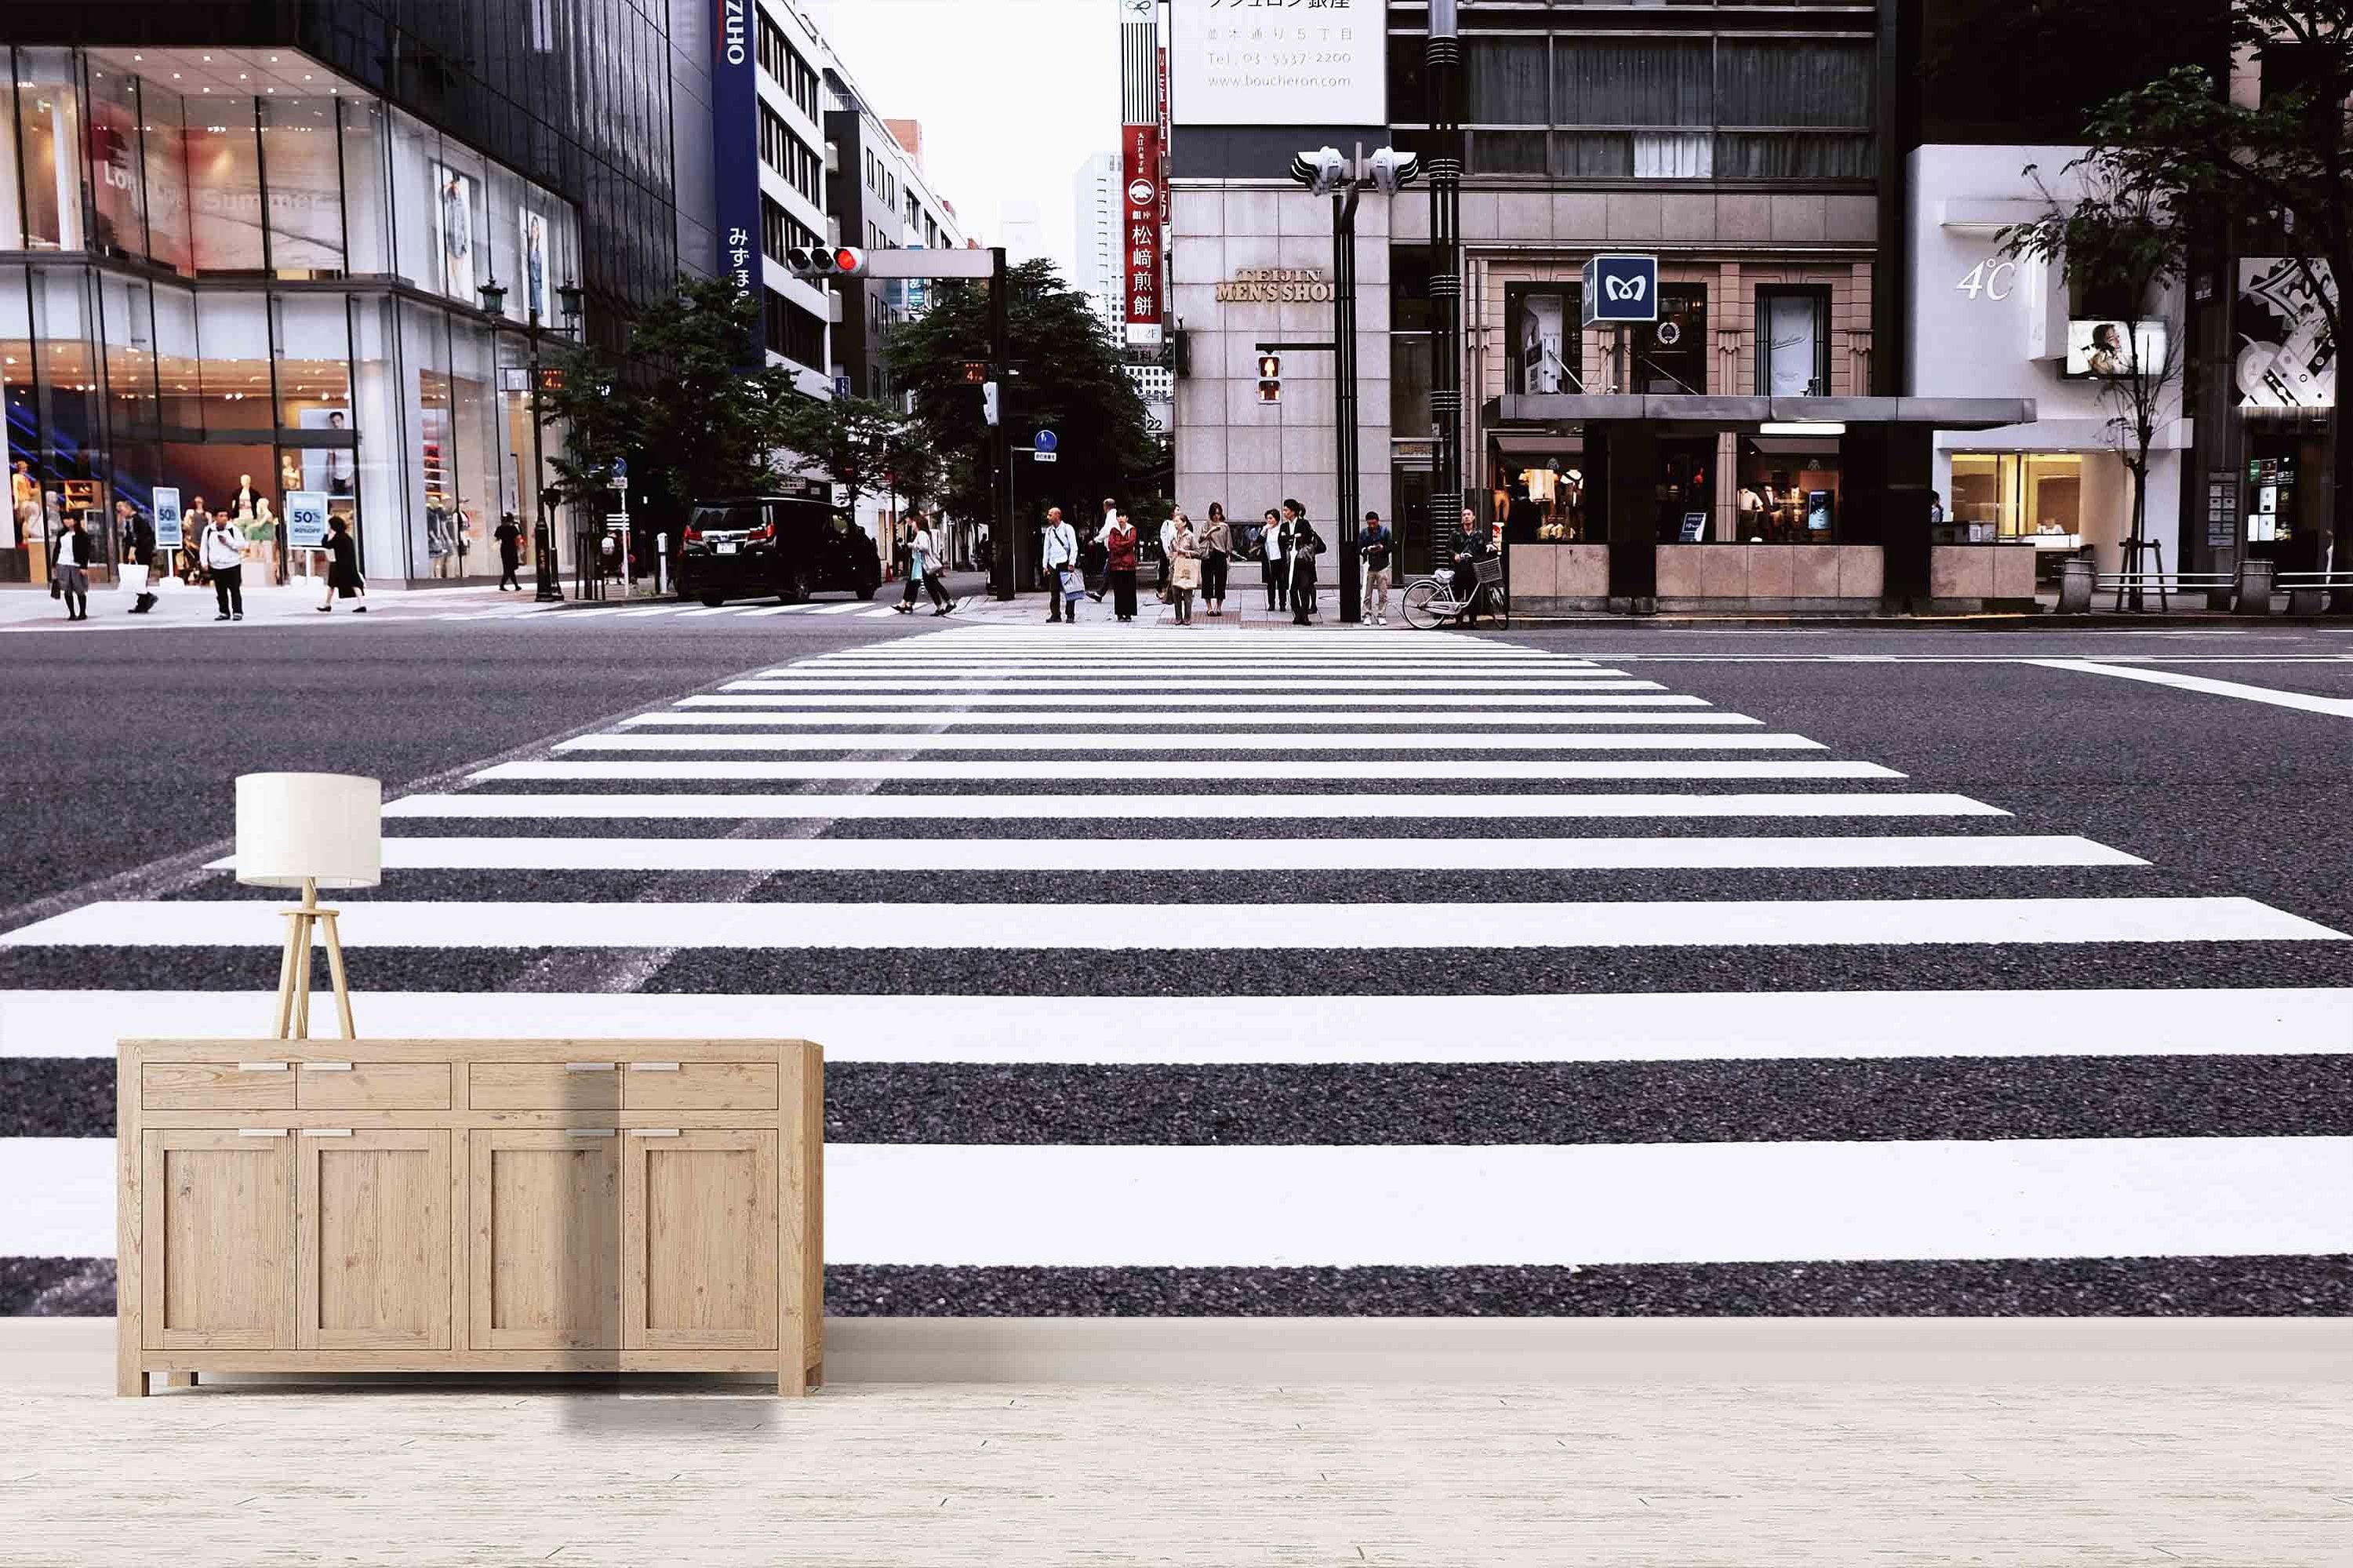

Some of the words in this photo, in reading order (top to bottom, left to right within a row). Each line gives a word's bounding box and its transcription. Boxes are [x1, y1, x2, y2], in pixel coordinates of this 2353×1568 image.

[729, 227, 750, 297] みずほ
[1236, 269, 1324, 282] TEIJIN
[1216, 282, 1279, 302] MEN'S
